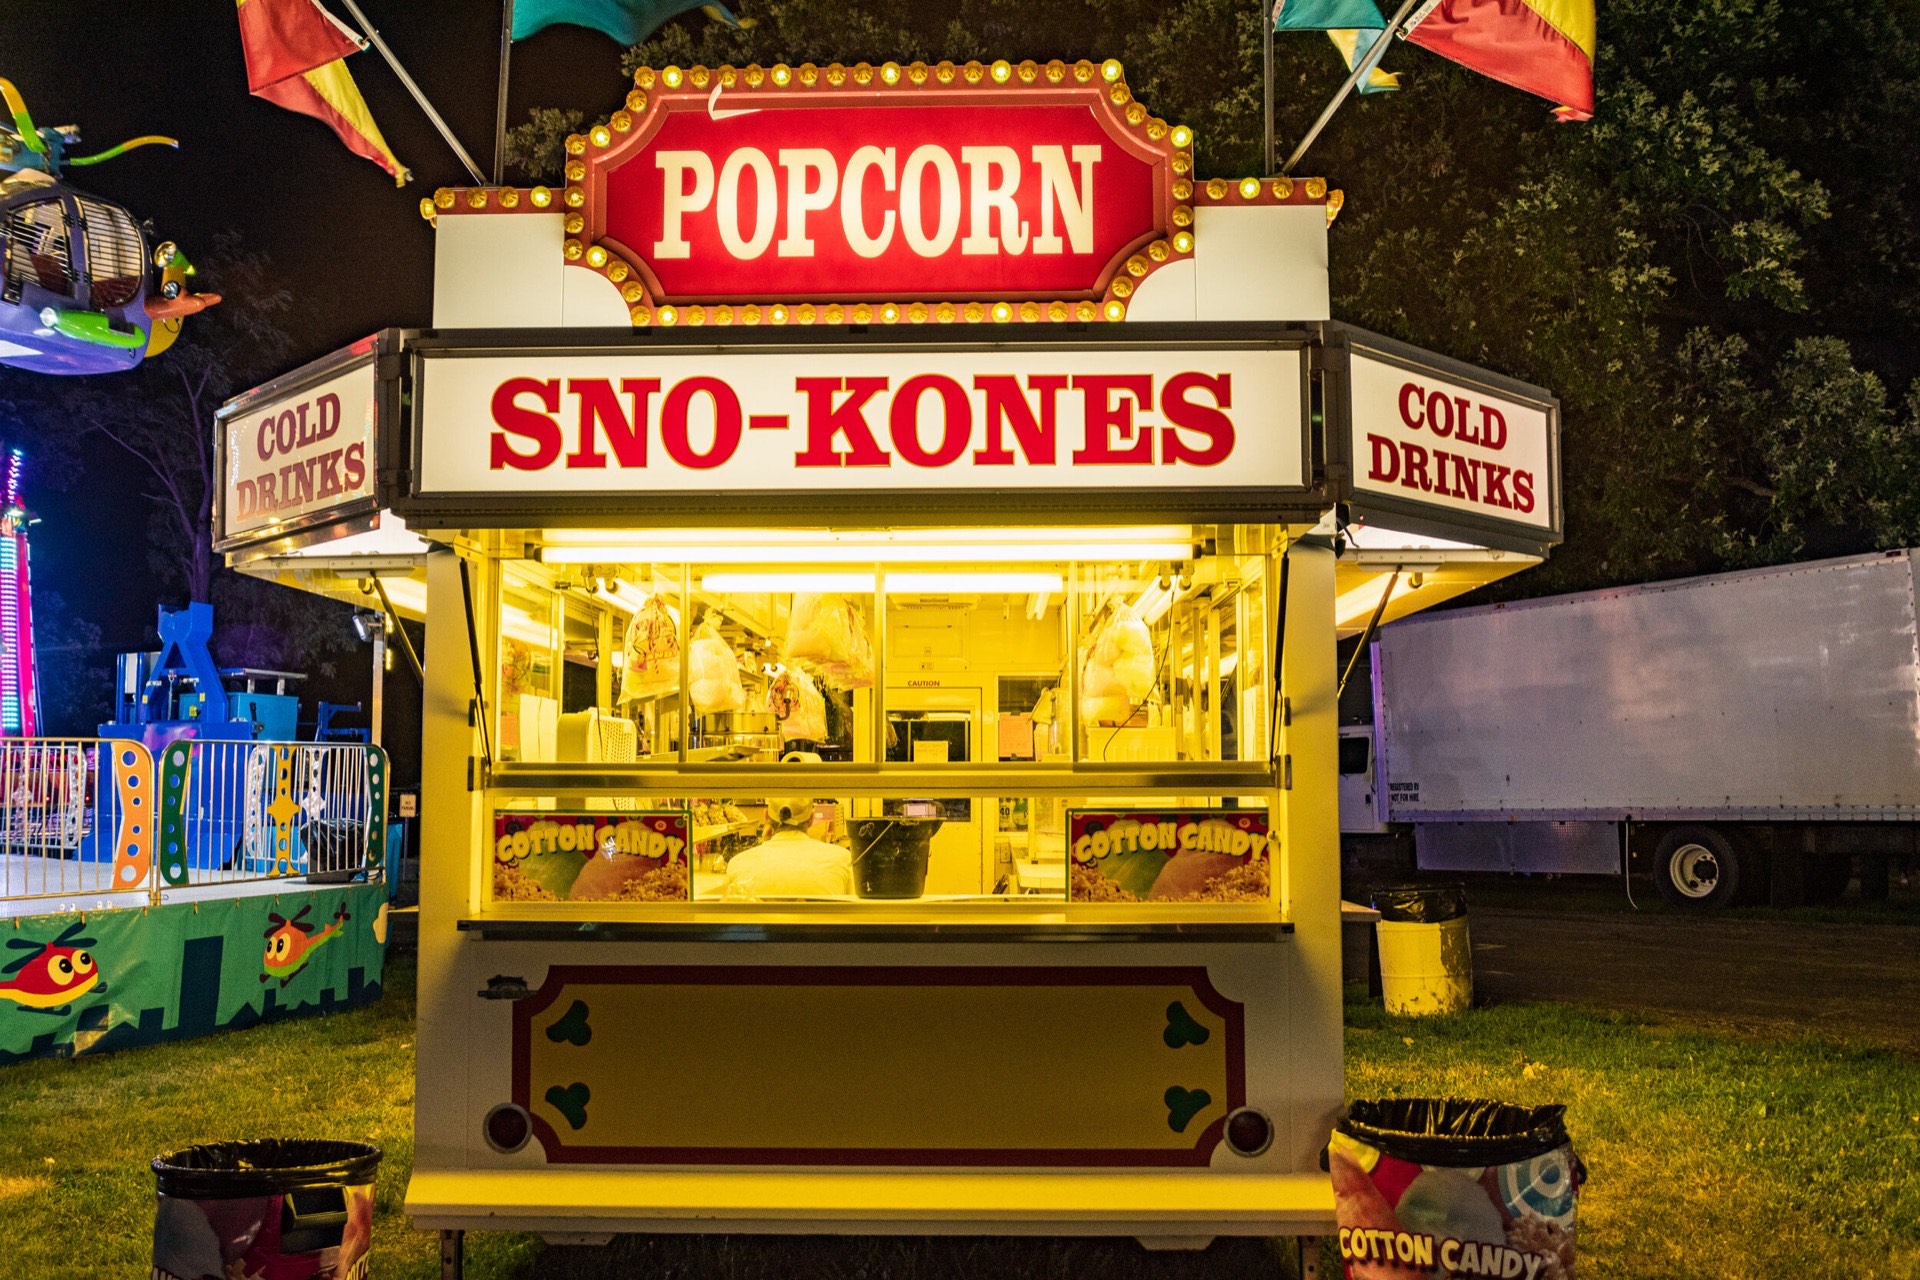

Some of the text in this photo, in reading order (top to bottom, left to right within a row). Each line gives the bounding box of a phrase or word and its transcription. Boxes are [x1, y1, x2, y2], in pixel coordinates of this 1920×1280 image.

[654, 143, 1103, 260] POPCORN
[256, 392, 341, 462] COLD
[490, 371, 1236, 472] SNO-KONES
[1398, 382, 1508, 451] COLD
[236, 440, 366, 523] DRINKS
[1366, 432, 1536, 514] DRINKS
[497, 824, 685, 864] COTTON CANDY
[1075, 822, 1269, 863] COTTON CANDY
[1338, 1227, 1543, 1280] COTTON CANDY
